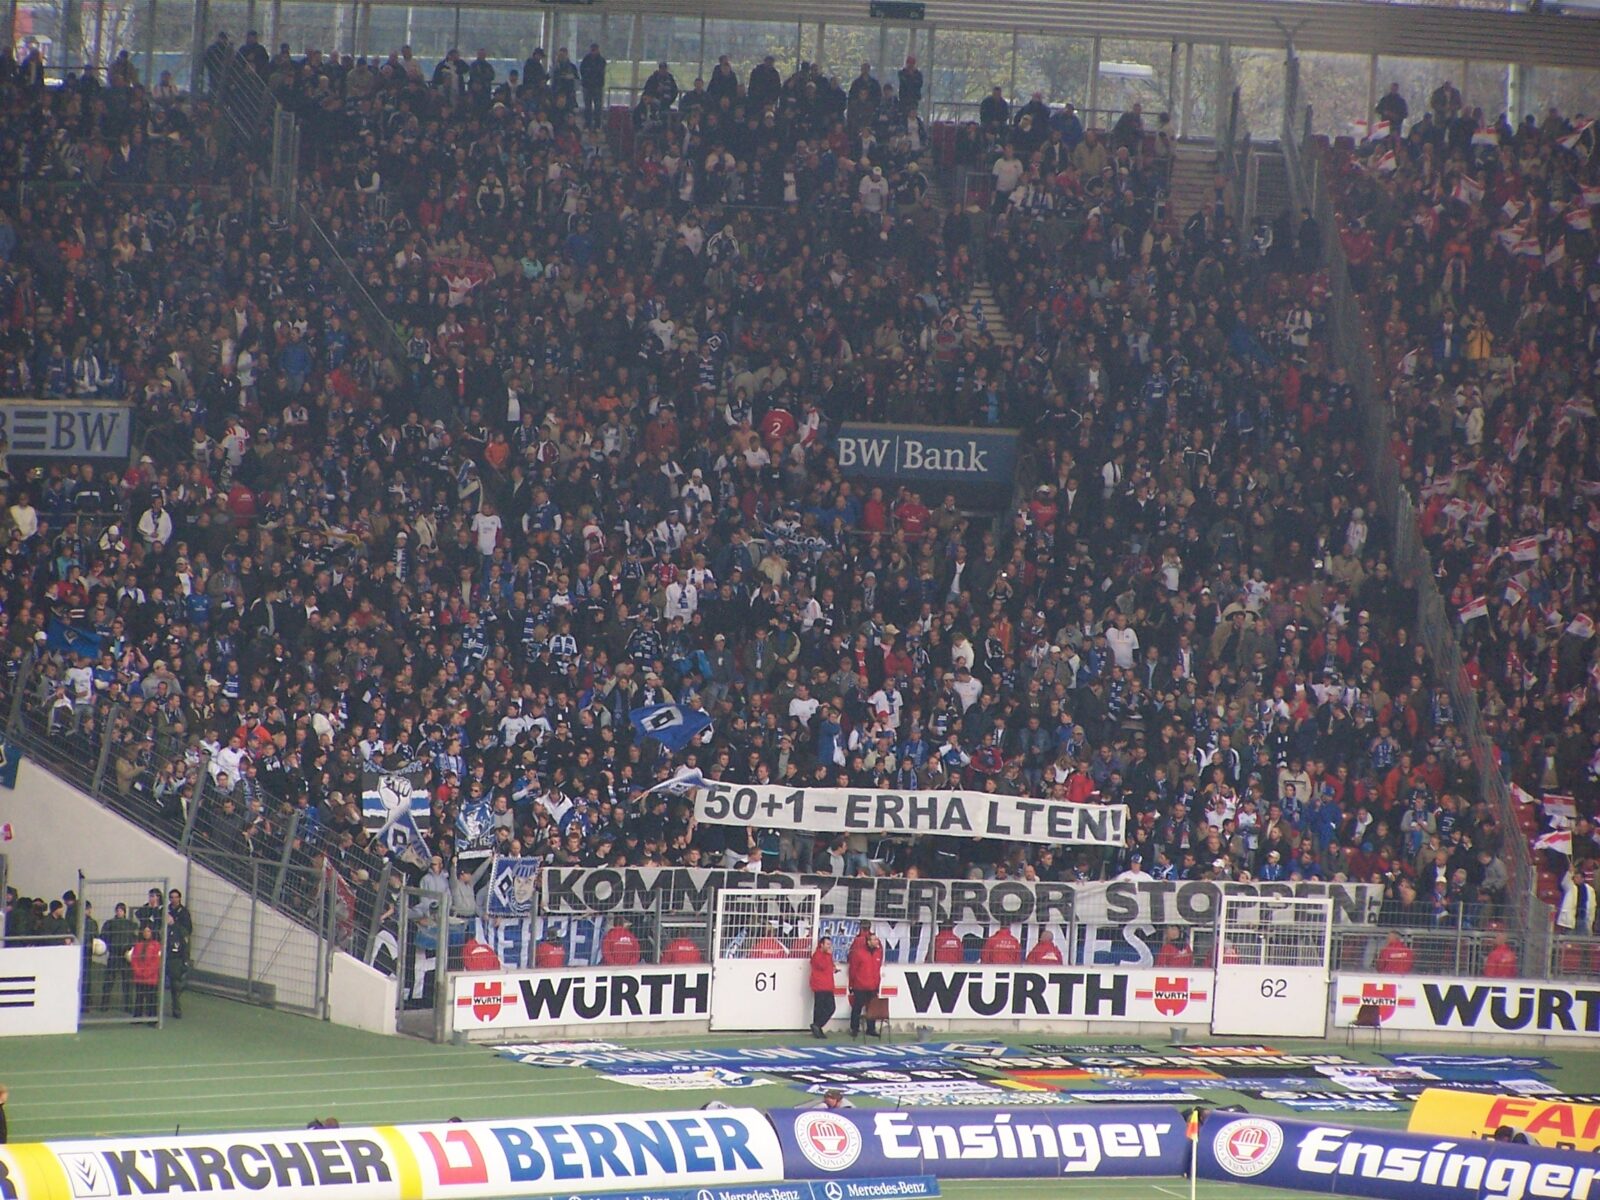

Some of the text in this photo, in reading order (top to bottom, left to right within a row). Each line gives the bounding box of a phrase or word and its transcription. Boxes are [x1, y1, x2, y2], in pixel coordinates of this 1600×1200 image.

[770, 422, 781, 436] 2
[838, 438, 988, 472] BW Bank
[519, 973, 710, 1021] WÜRTH
[755, 972, 778, 992] 61
[904, 971, 1129, 1017] WÜRTH
[1260, 978, 1288, 998] 62
[490, 1117, 763, 1182] BERNER
[874, 1111, 1172, 1173] Ensinger
[101, 1139, 392, 1196] KÄRCHER
[719, 1189, 800, 1200] Mercedes-Benz
[848, 1181, 927, 1197] Mercedes-Benz
